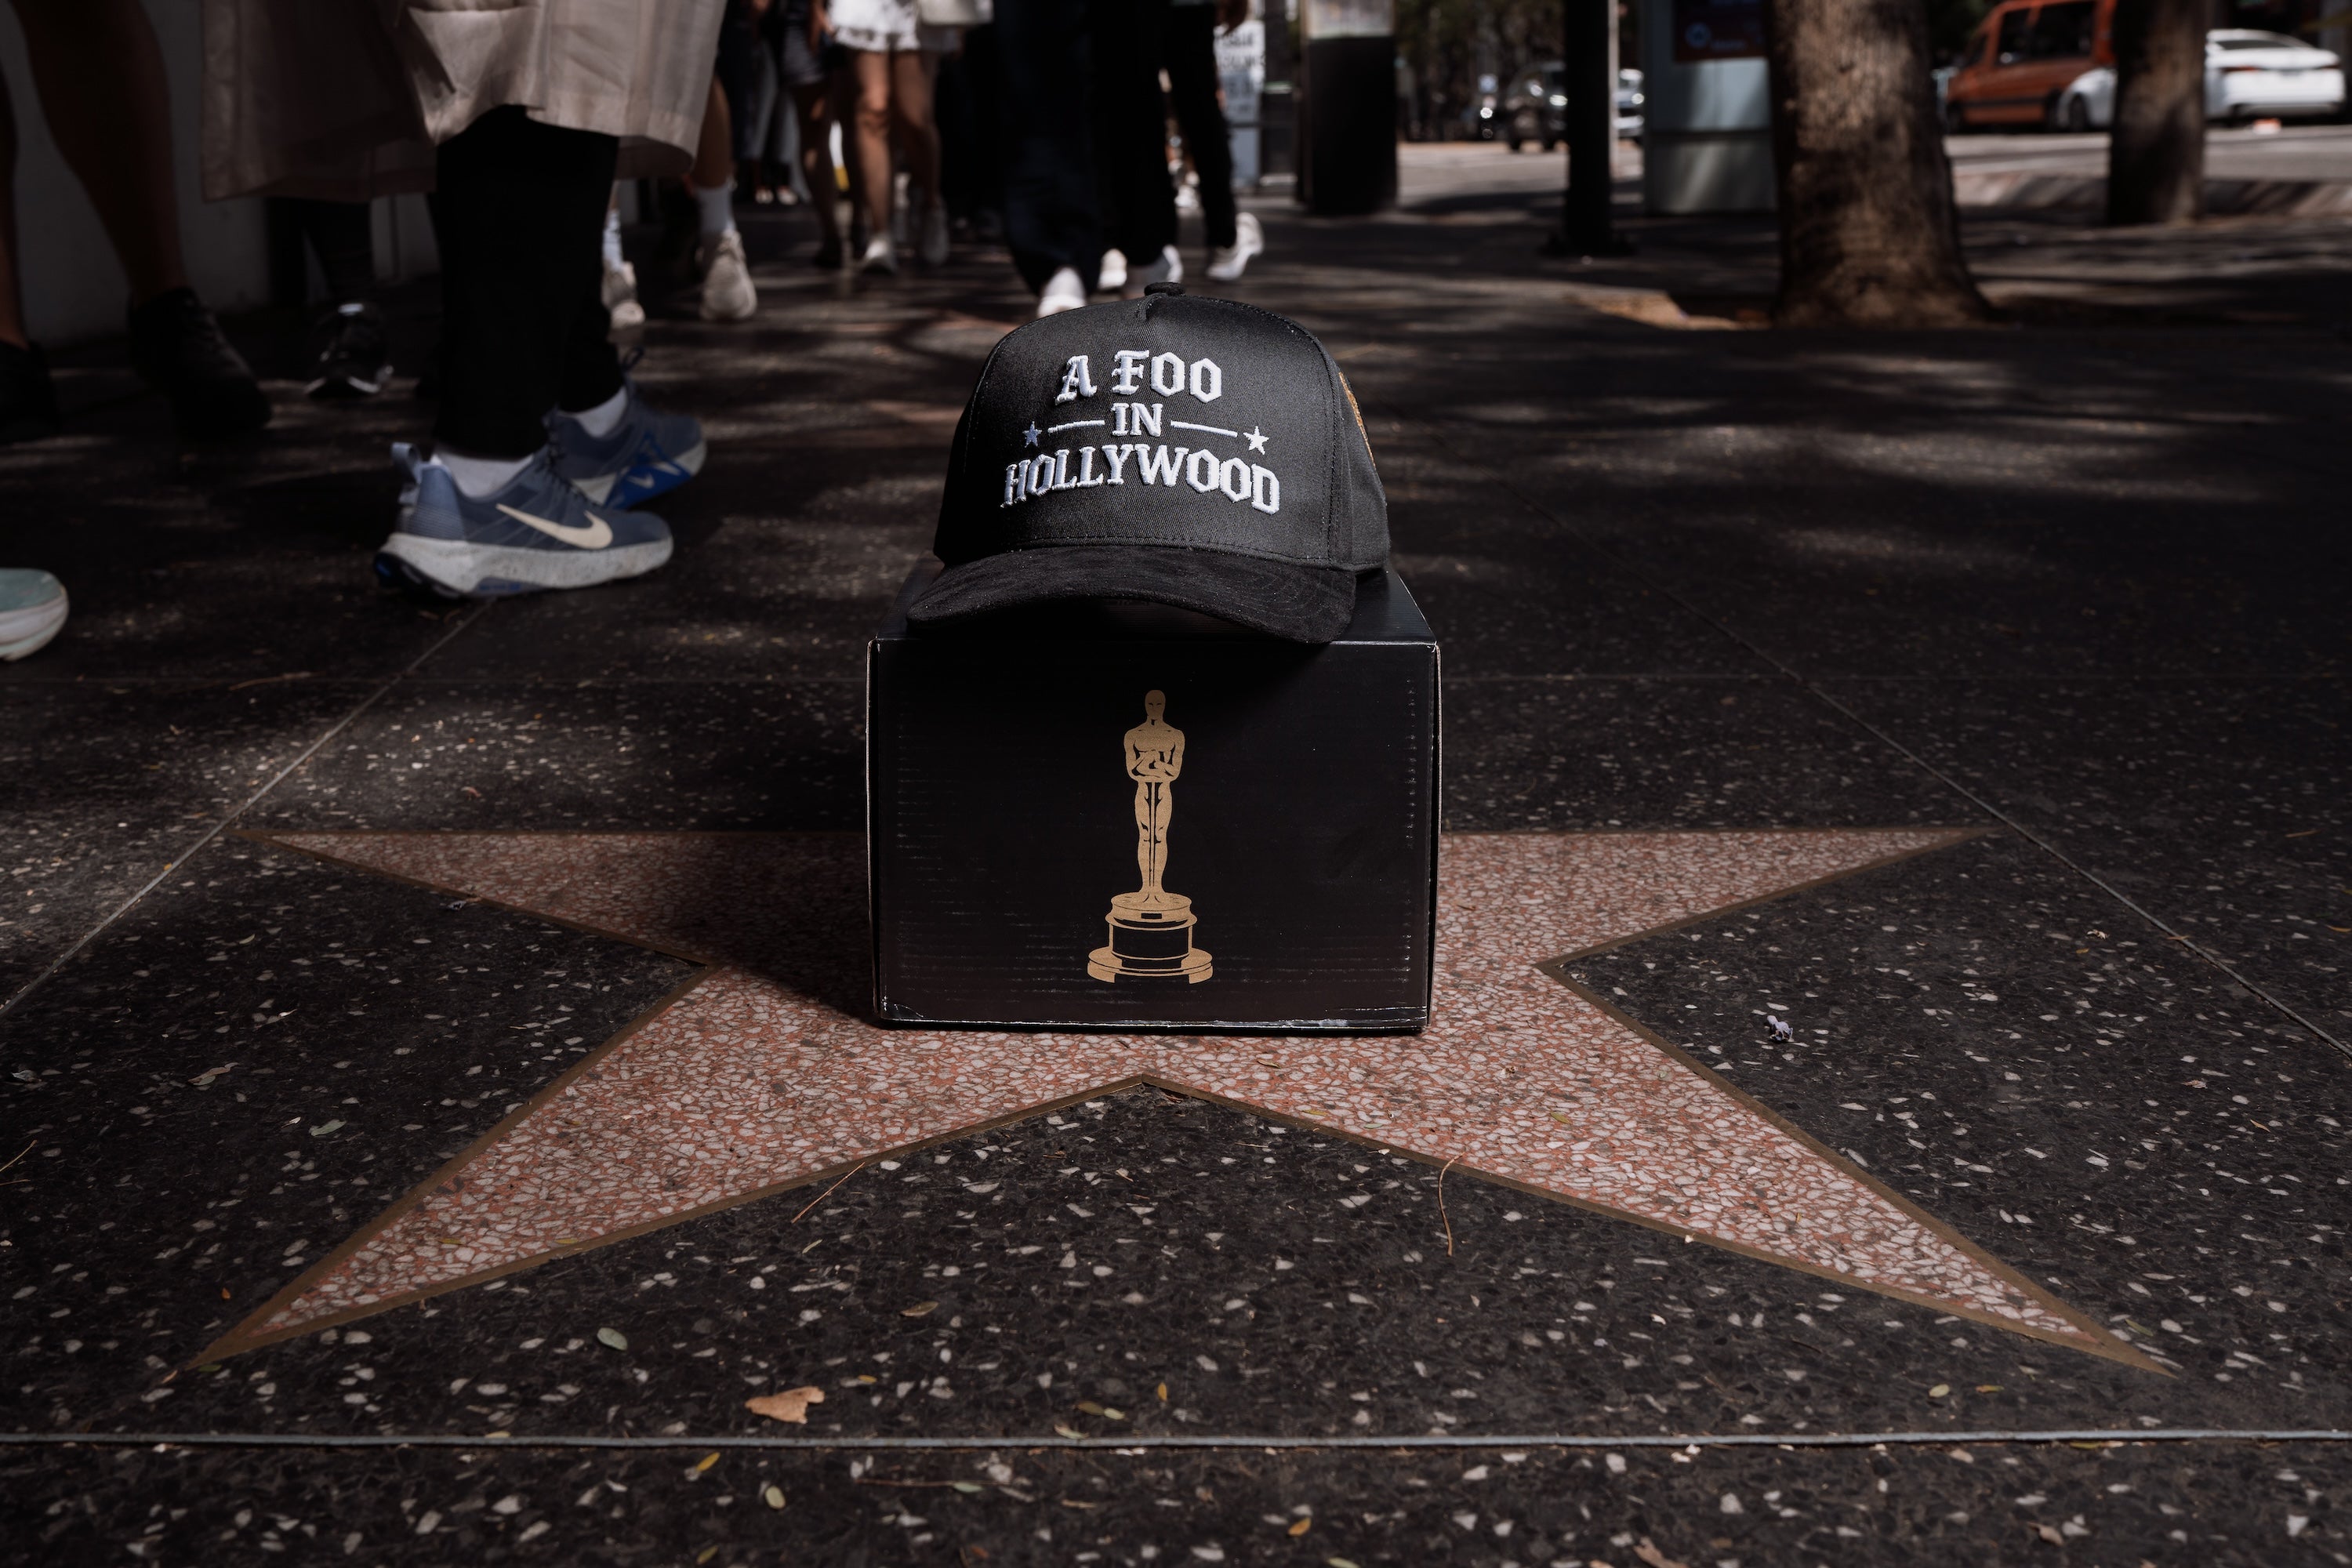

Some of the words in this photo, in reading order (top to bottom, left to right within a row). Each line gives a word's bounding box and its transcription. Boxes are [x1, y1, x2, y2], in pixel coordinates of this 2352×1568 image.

[1054, 354, 1098, 406] A
[1111, 350, 1222, 403] FOO
[1110, 403, 1163, 437] IN
[1000, 444, 1280, 515] HOLLYWOOD
